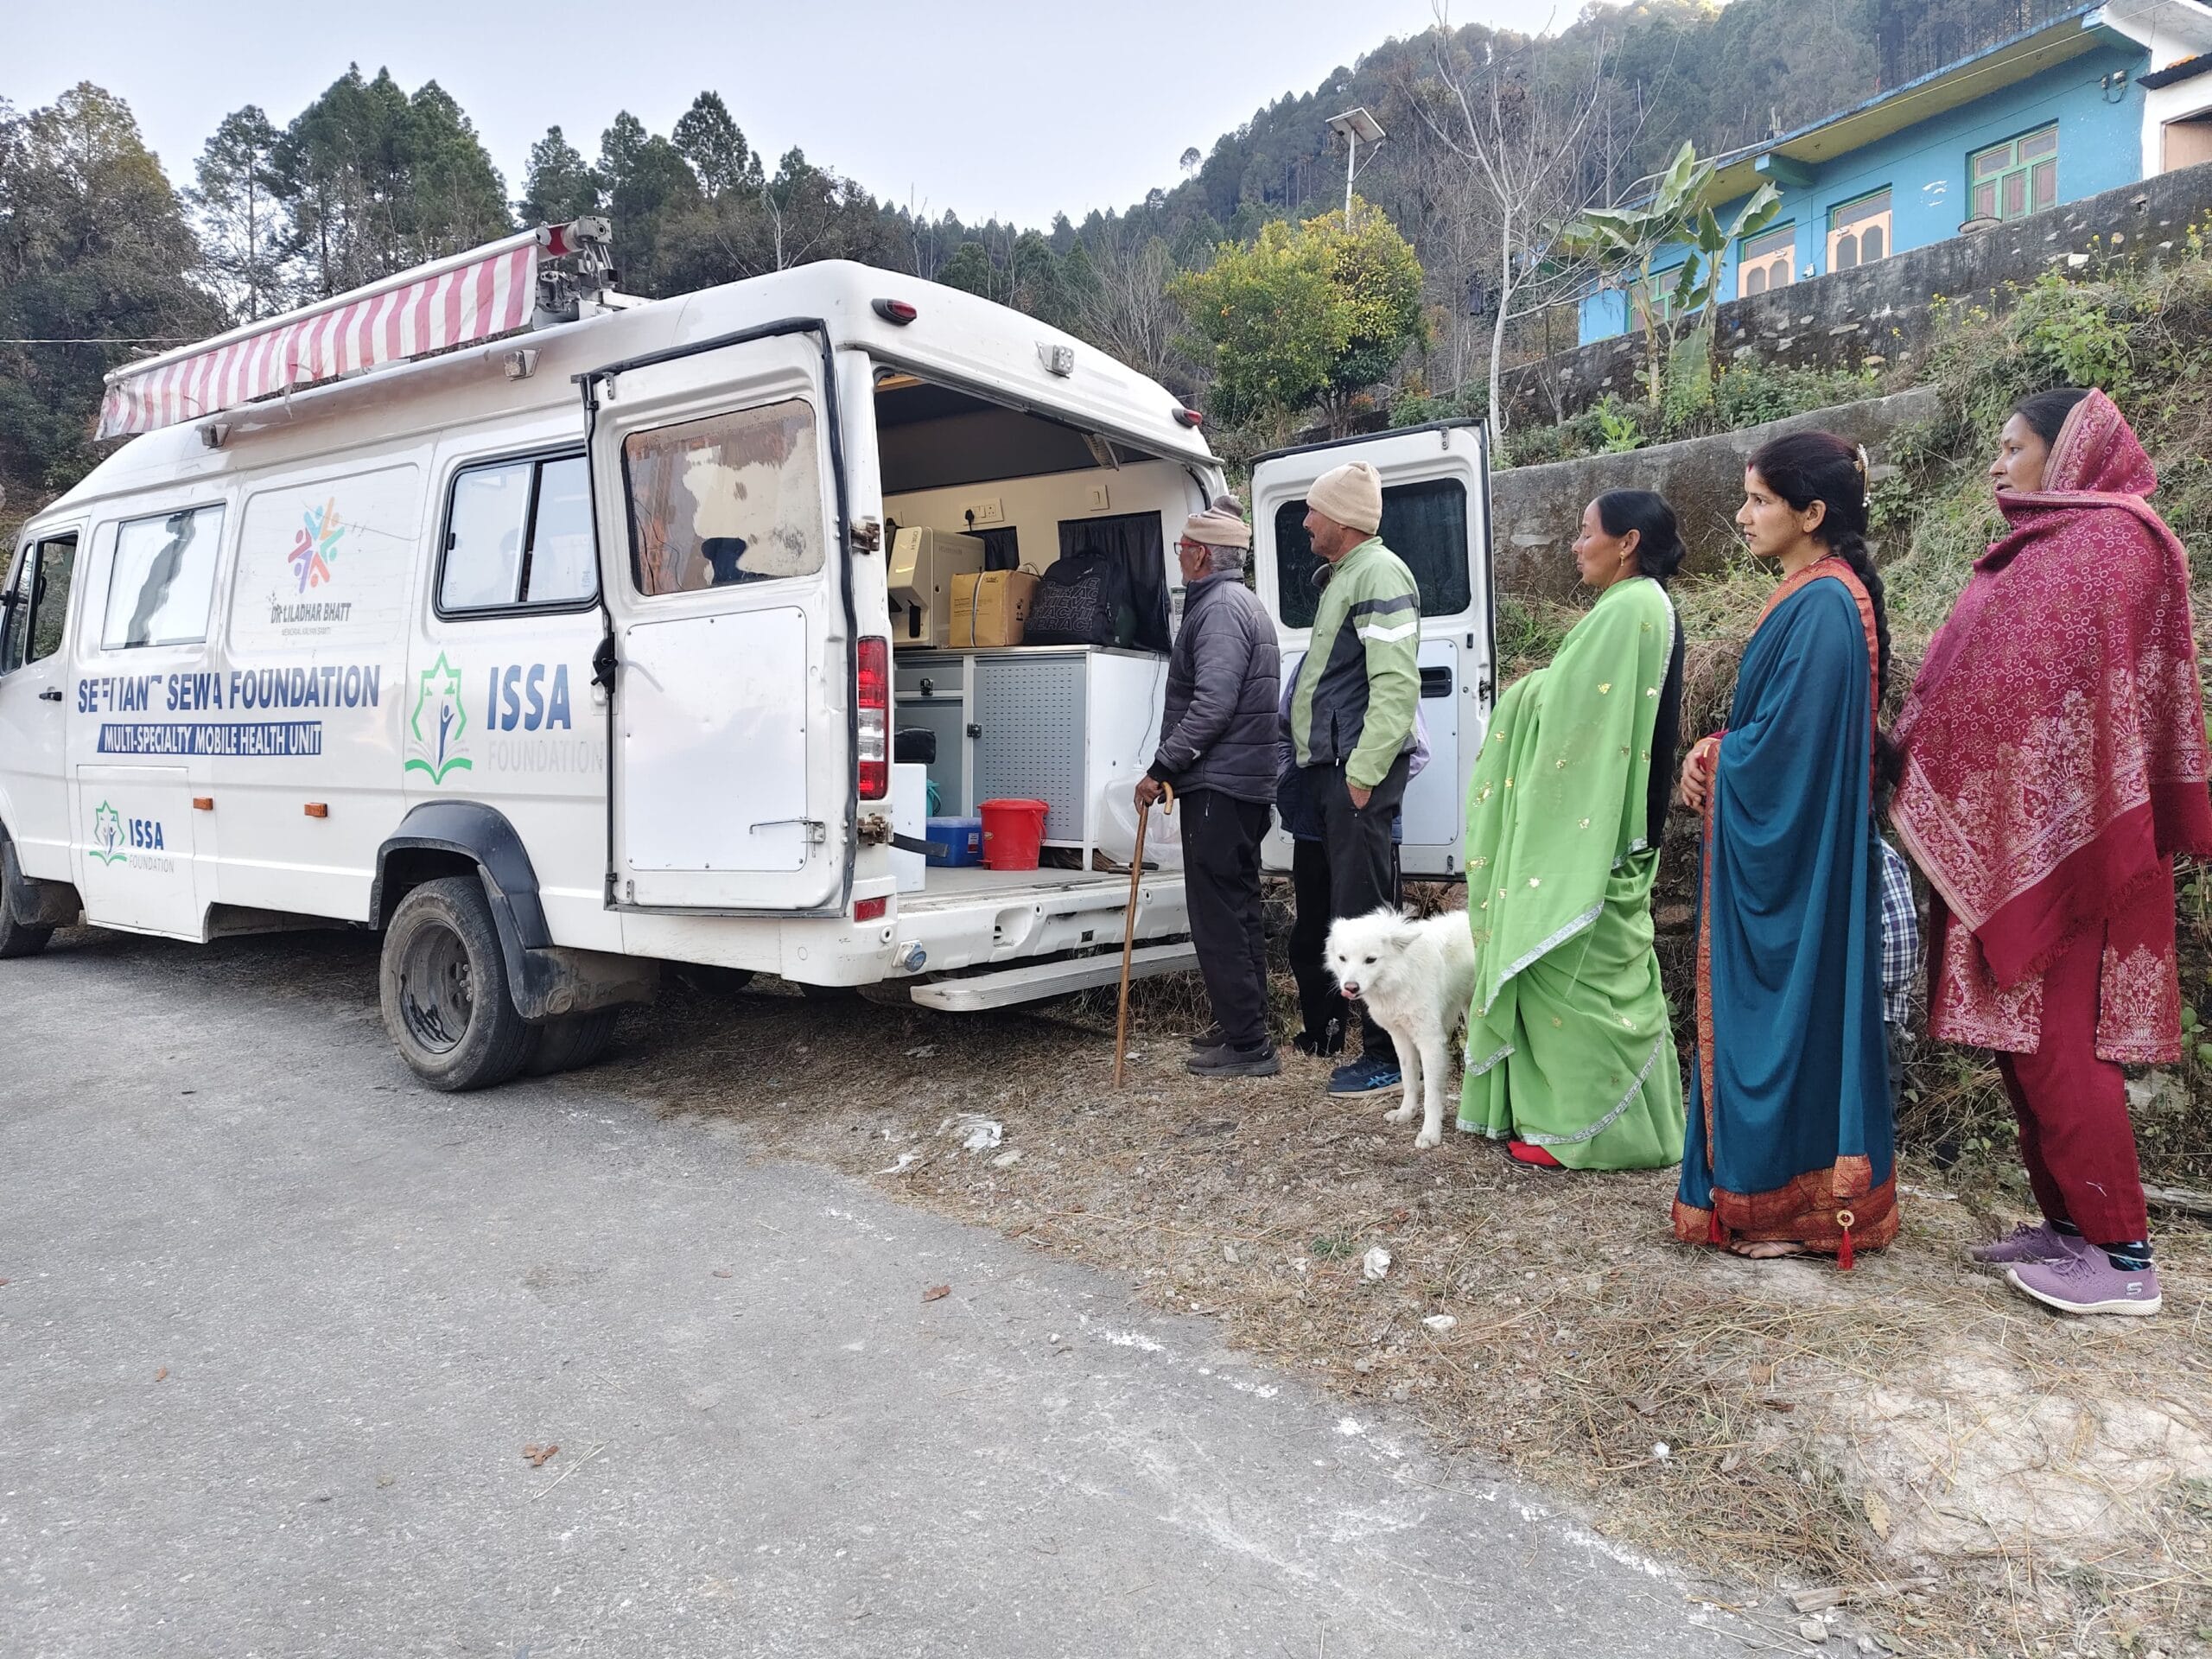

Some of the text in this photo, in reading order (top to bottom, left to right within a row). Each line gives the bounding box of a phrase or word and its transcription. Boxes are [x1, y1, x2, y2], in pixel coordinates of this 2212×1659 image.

[283, 603, 322, 622] LILADHAR
[323, 602, 352, 622] BHATT
[167, 672, 223, 711] SEWA
[229, 664, 380, 710] FOUNDATION
[486, 664, 572, 732] ISSA
[104, 724, 321, 754] MULTI-SPECIALTY MOBILE HEALTH UNIT
[486, 740, 604, 774] FOUNDATION
[129, 818, 164, 850] ISSA
[129, 854, 175, 874] FOUNDATION
